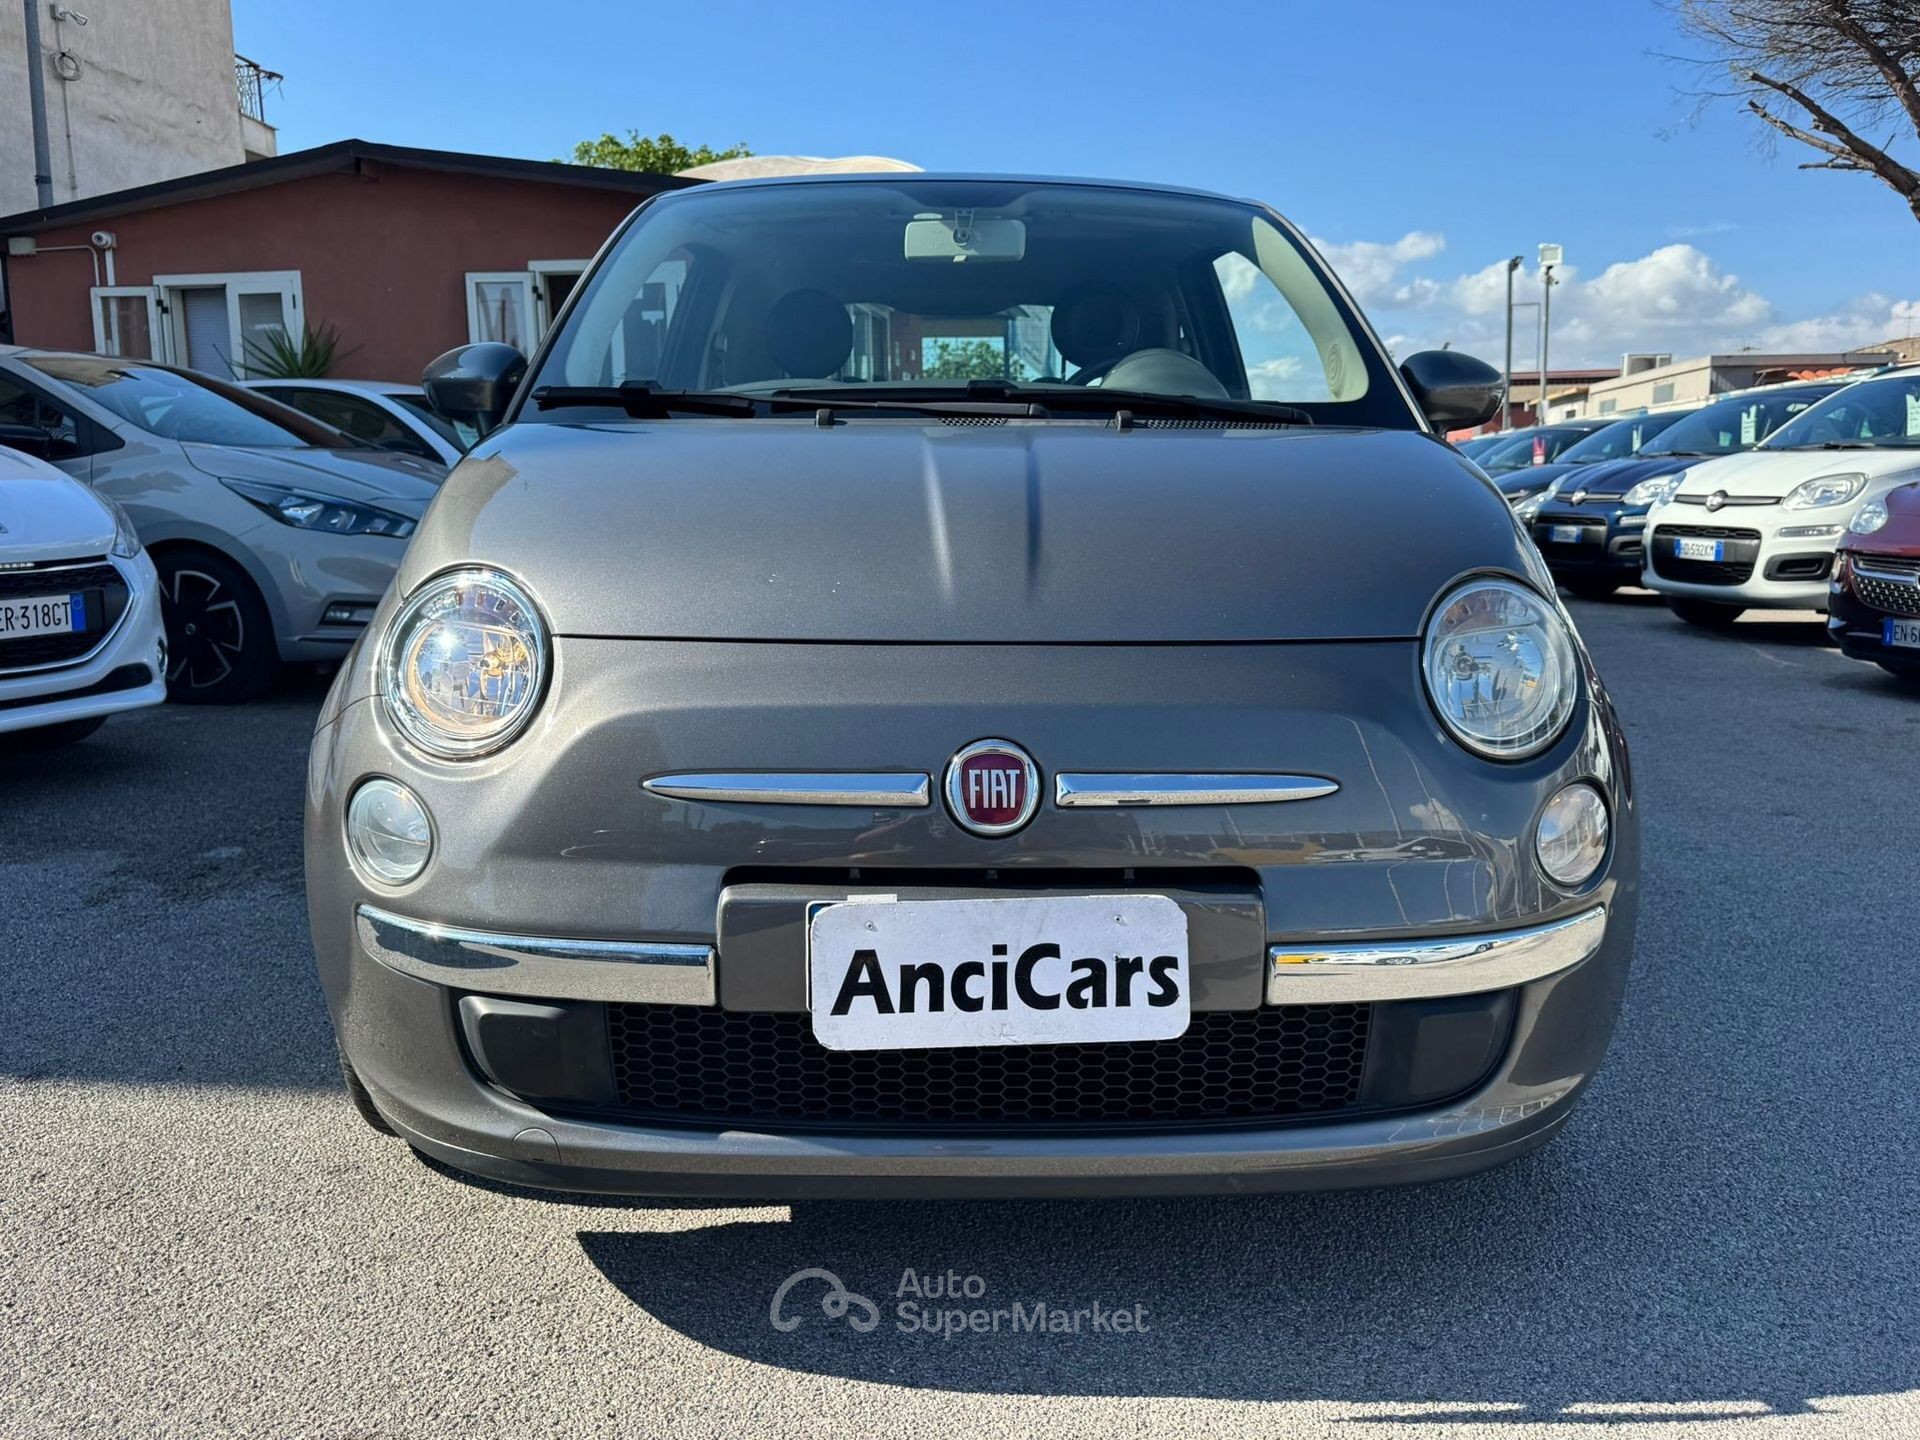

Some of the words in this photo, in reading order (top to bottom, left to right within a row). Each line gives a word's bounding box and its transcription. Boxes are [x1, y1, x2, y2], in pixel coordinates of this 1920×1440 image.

[20, 602, 70, 630] 318GT
[1893, 624, 1908, 642] EN
[968, 769, 1021, 809] FIAT
[830, 943, 1179, 1015] AnciCars
